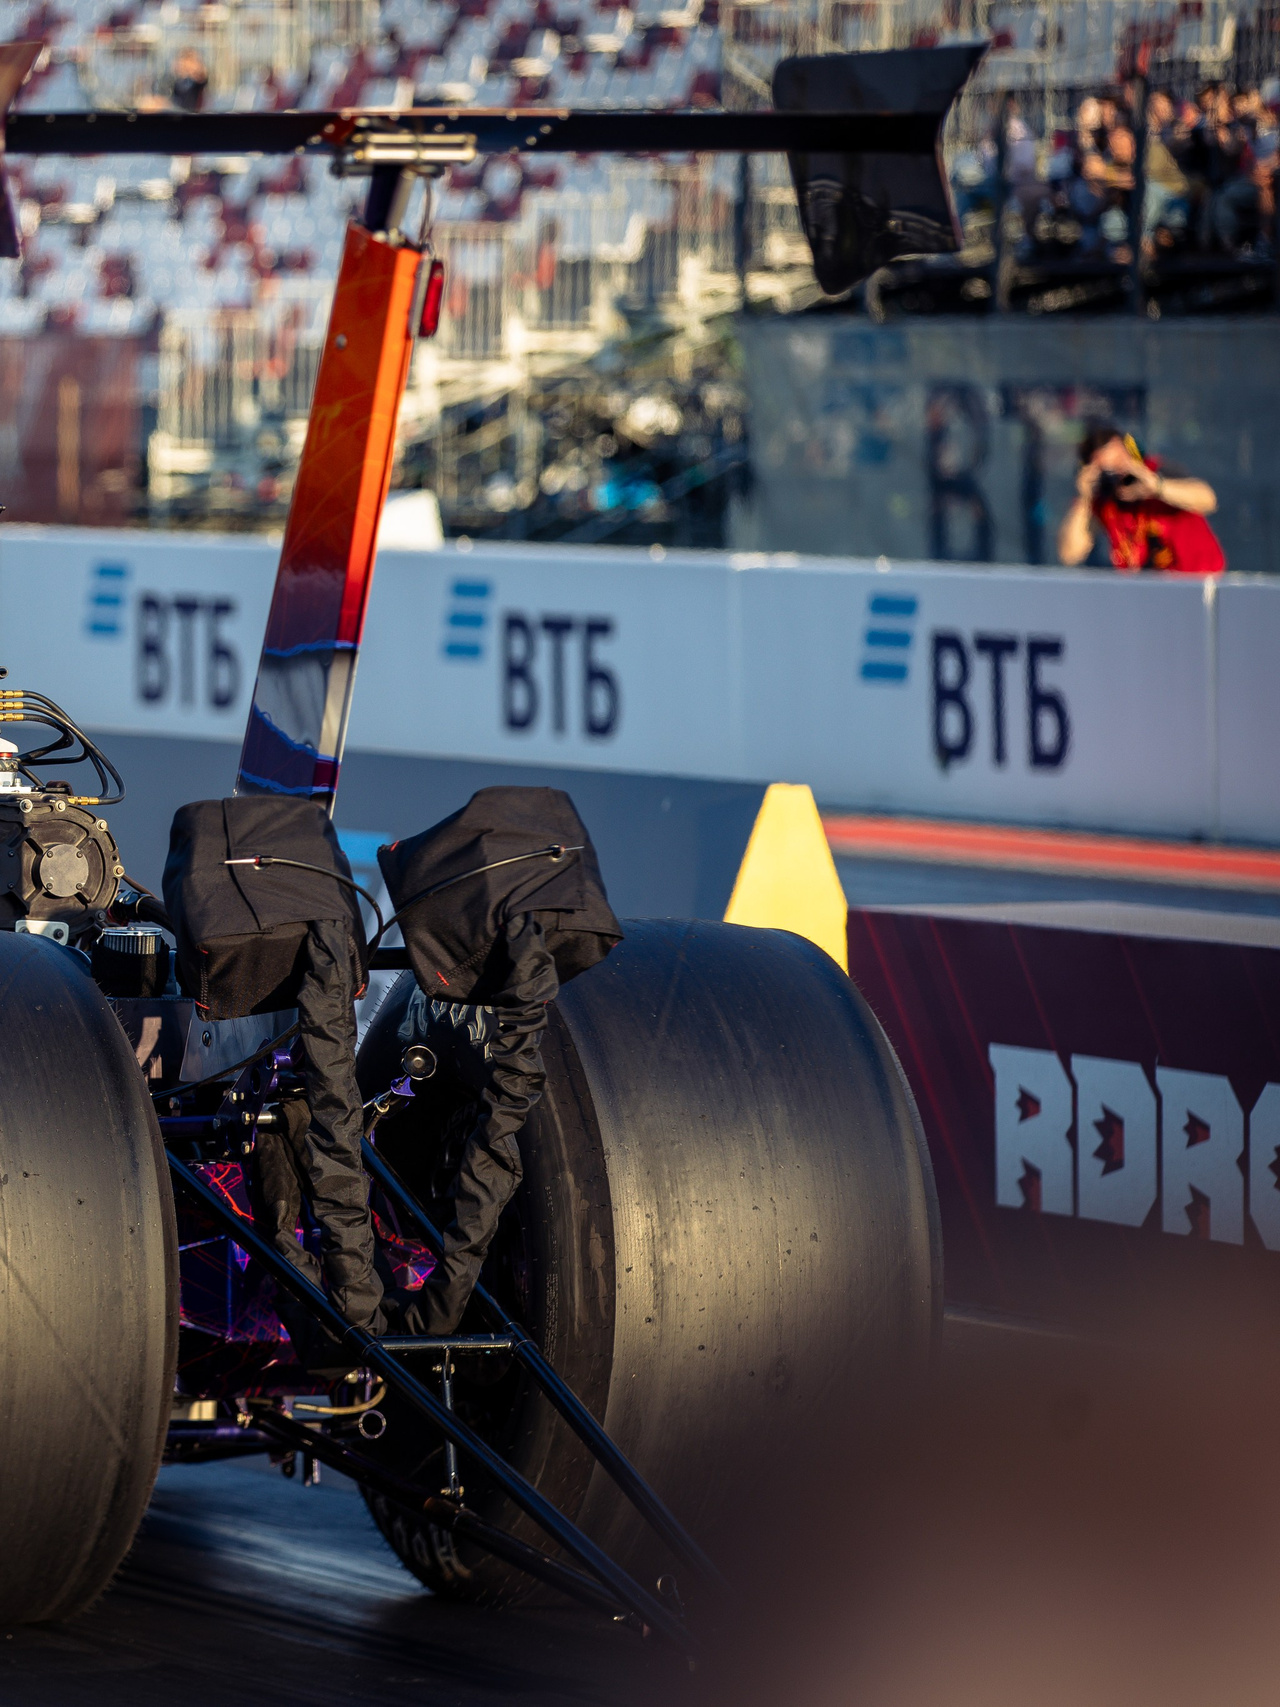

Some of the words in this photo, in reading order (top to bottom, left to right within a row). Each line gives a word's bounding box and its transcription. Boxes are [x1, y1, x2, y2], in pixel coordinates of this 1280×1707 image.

[135, 589, 241, 710] ВТБ
[501, 611, 621, 740] ВТБ
[931, 629, 1071, 771] ВТБ
